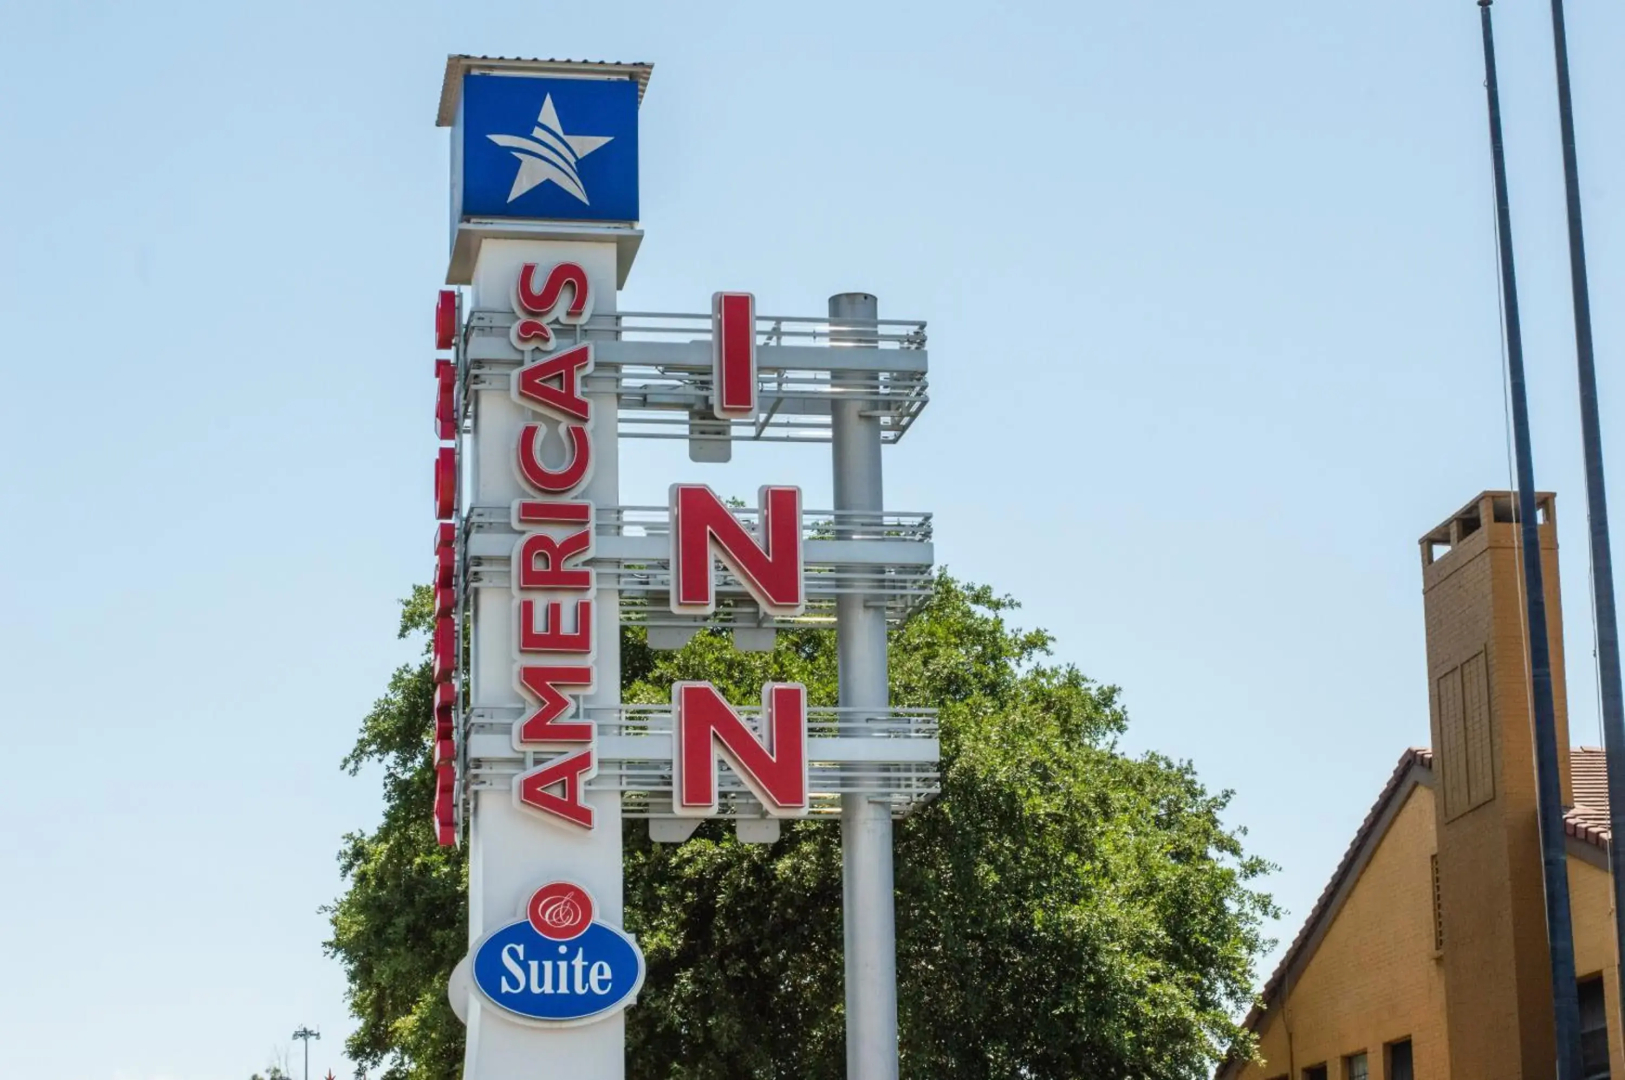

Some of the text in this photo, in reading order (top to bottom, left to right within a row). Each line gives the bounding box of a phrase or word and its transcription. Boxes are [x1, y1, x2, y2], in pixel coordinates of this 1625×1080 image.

[518, 261, 594, 829] AMERICA'S
[677, 293, 806, 808] INN
[501, 943, 613, 996] Suite
